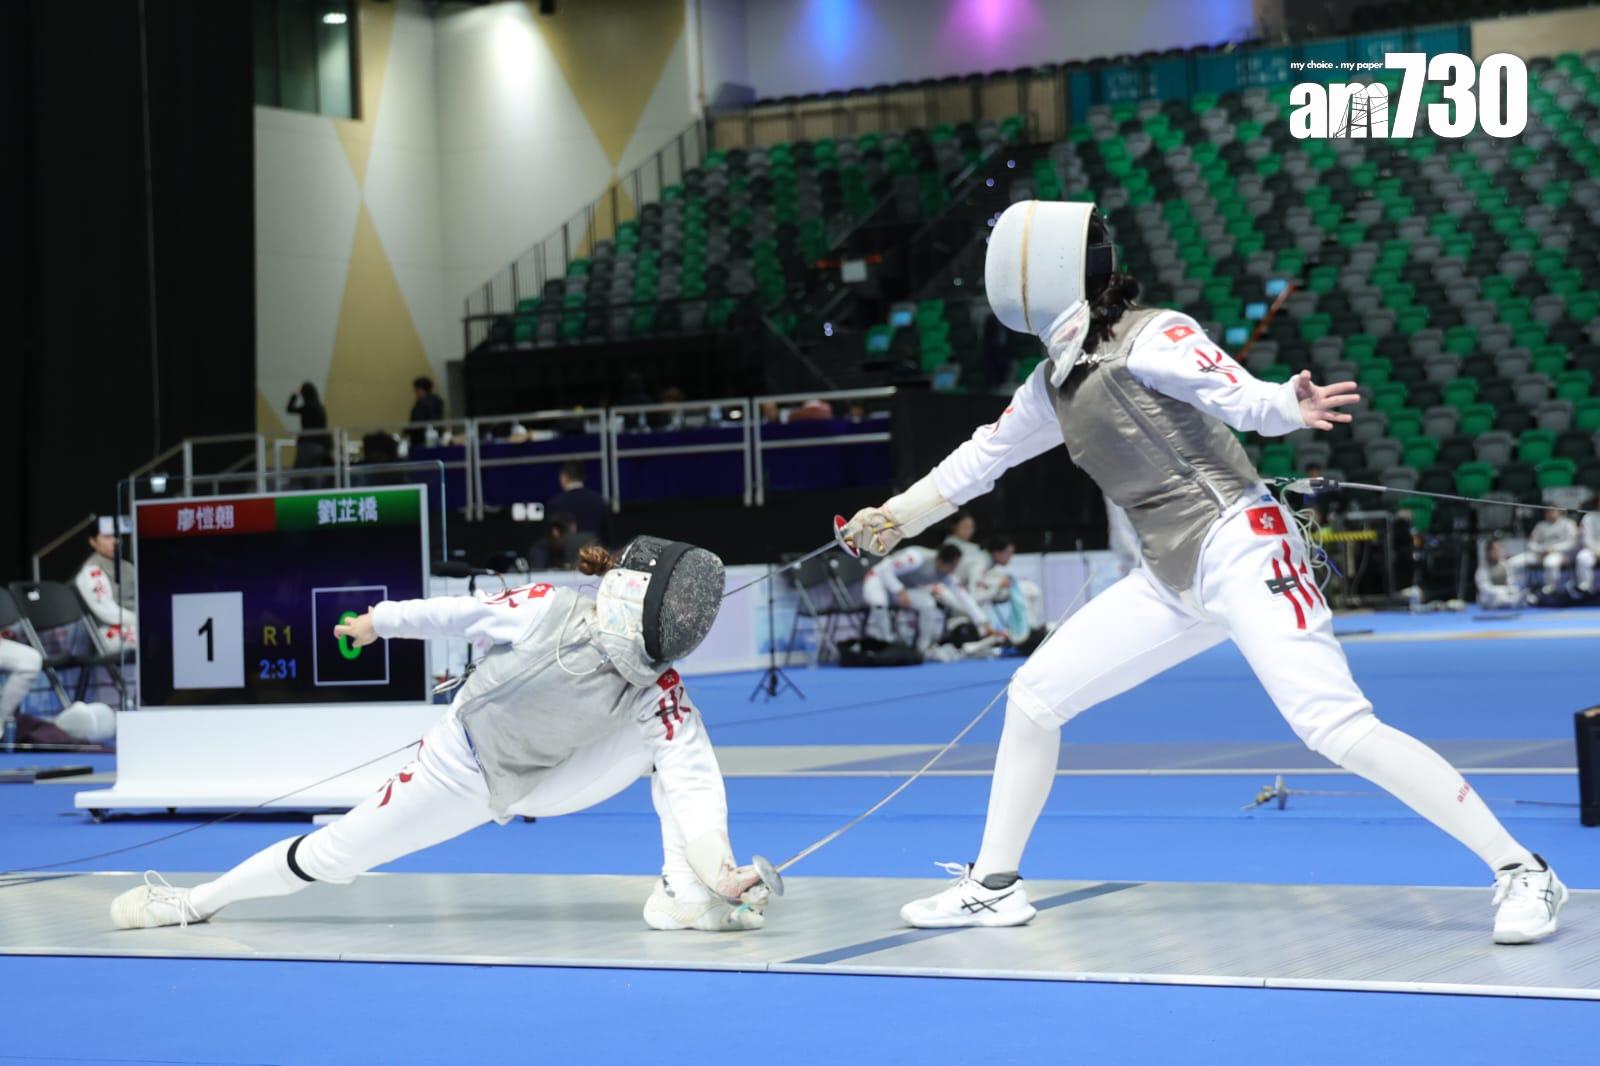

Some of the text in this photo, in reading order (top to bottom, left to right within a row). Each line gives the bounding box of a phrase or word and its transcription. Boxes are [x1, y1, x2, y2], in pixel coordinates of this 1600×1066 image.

[318, 496, 378, 525] 劉芷橋
[198, 617, 214, 662] 1
[259, 659, 297, 680] 2:31
